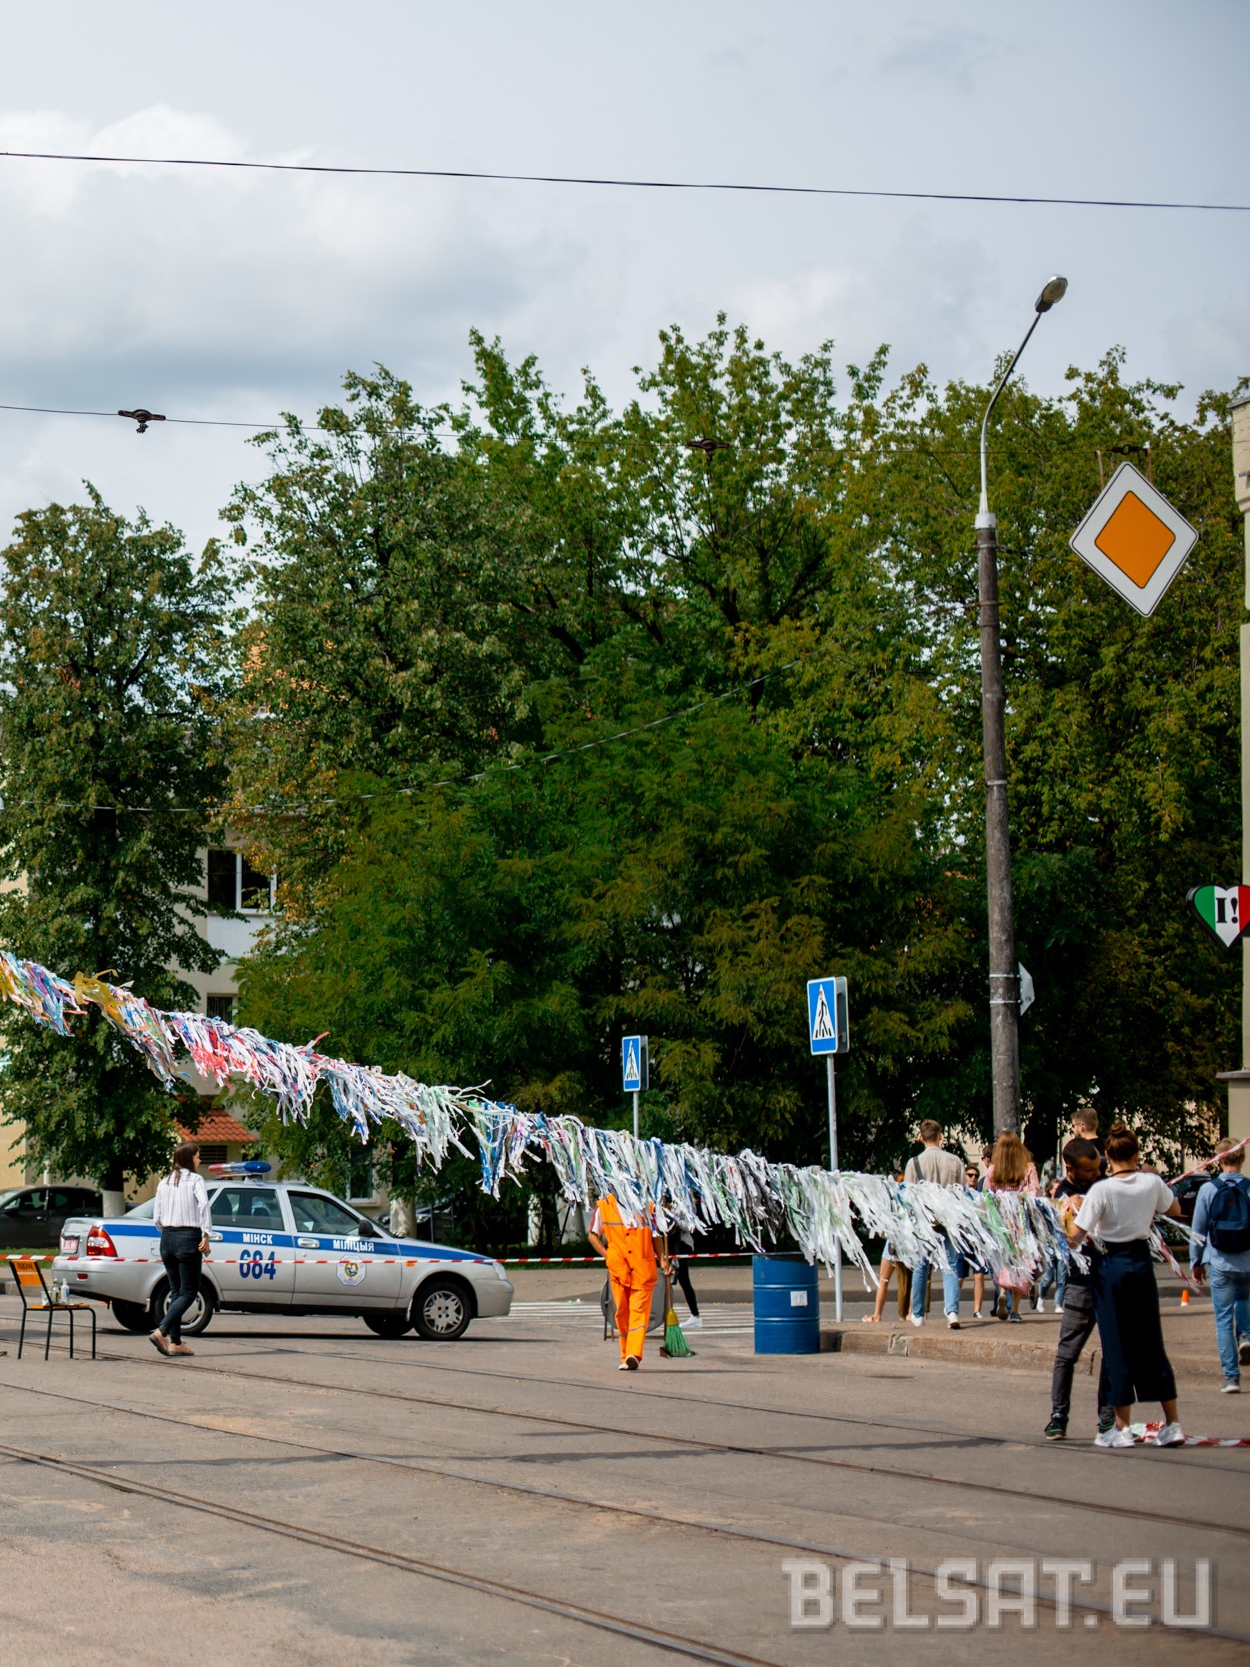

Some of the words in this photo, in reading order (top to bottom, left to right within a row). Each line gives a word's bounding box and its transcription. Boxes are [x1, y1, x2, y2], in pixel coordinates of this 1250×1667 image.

[1215, 897, 1239, 924] I!
[243, 1232, 273, 1245] МІНСК
[333, 1239, 375, 1252] МІЛІЦЫЯ
[239, 1249, 276, 1280] 684
